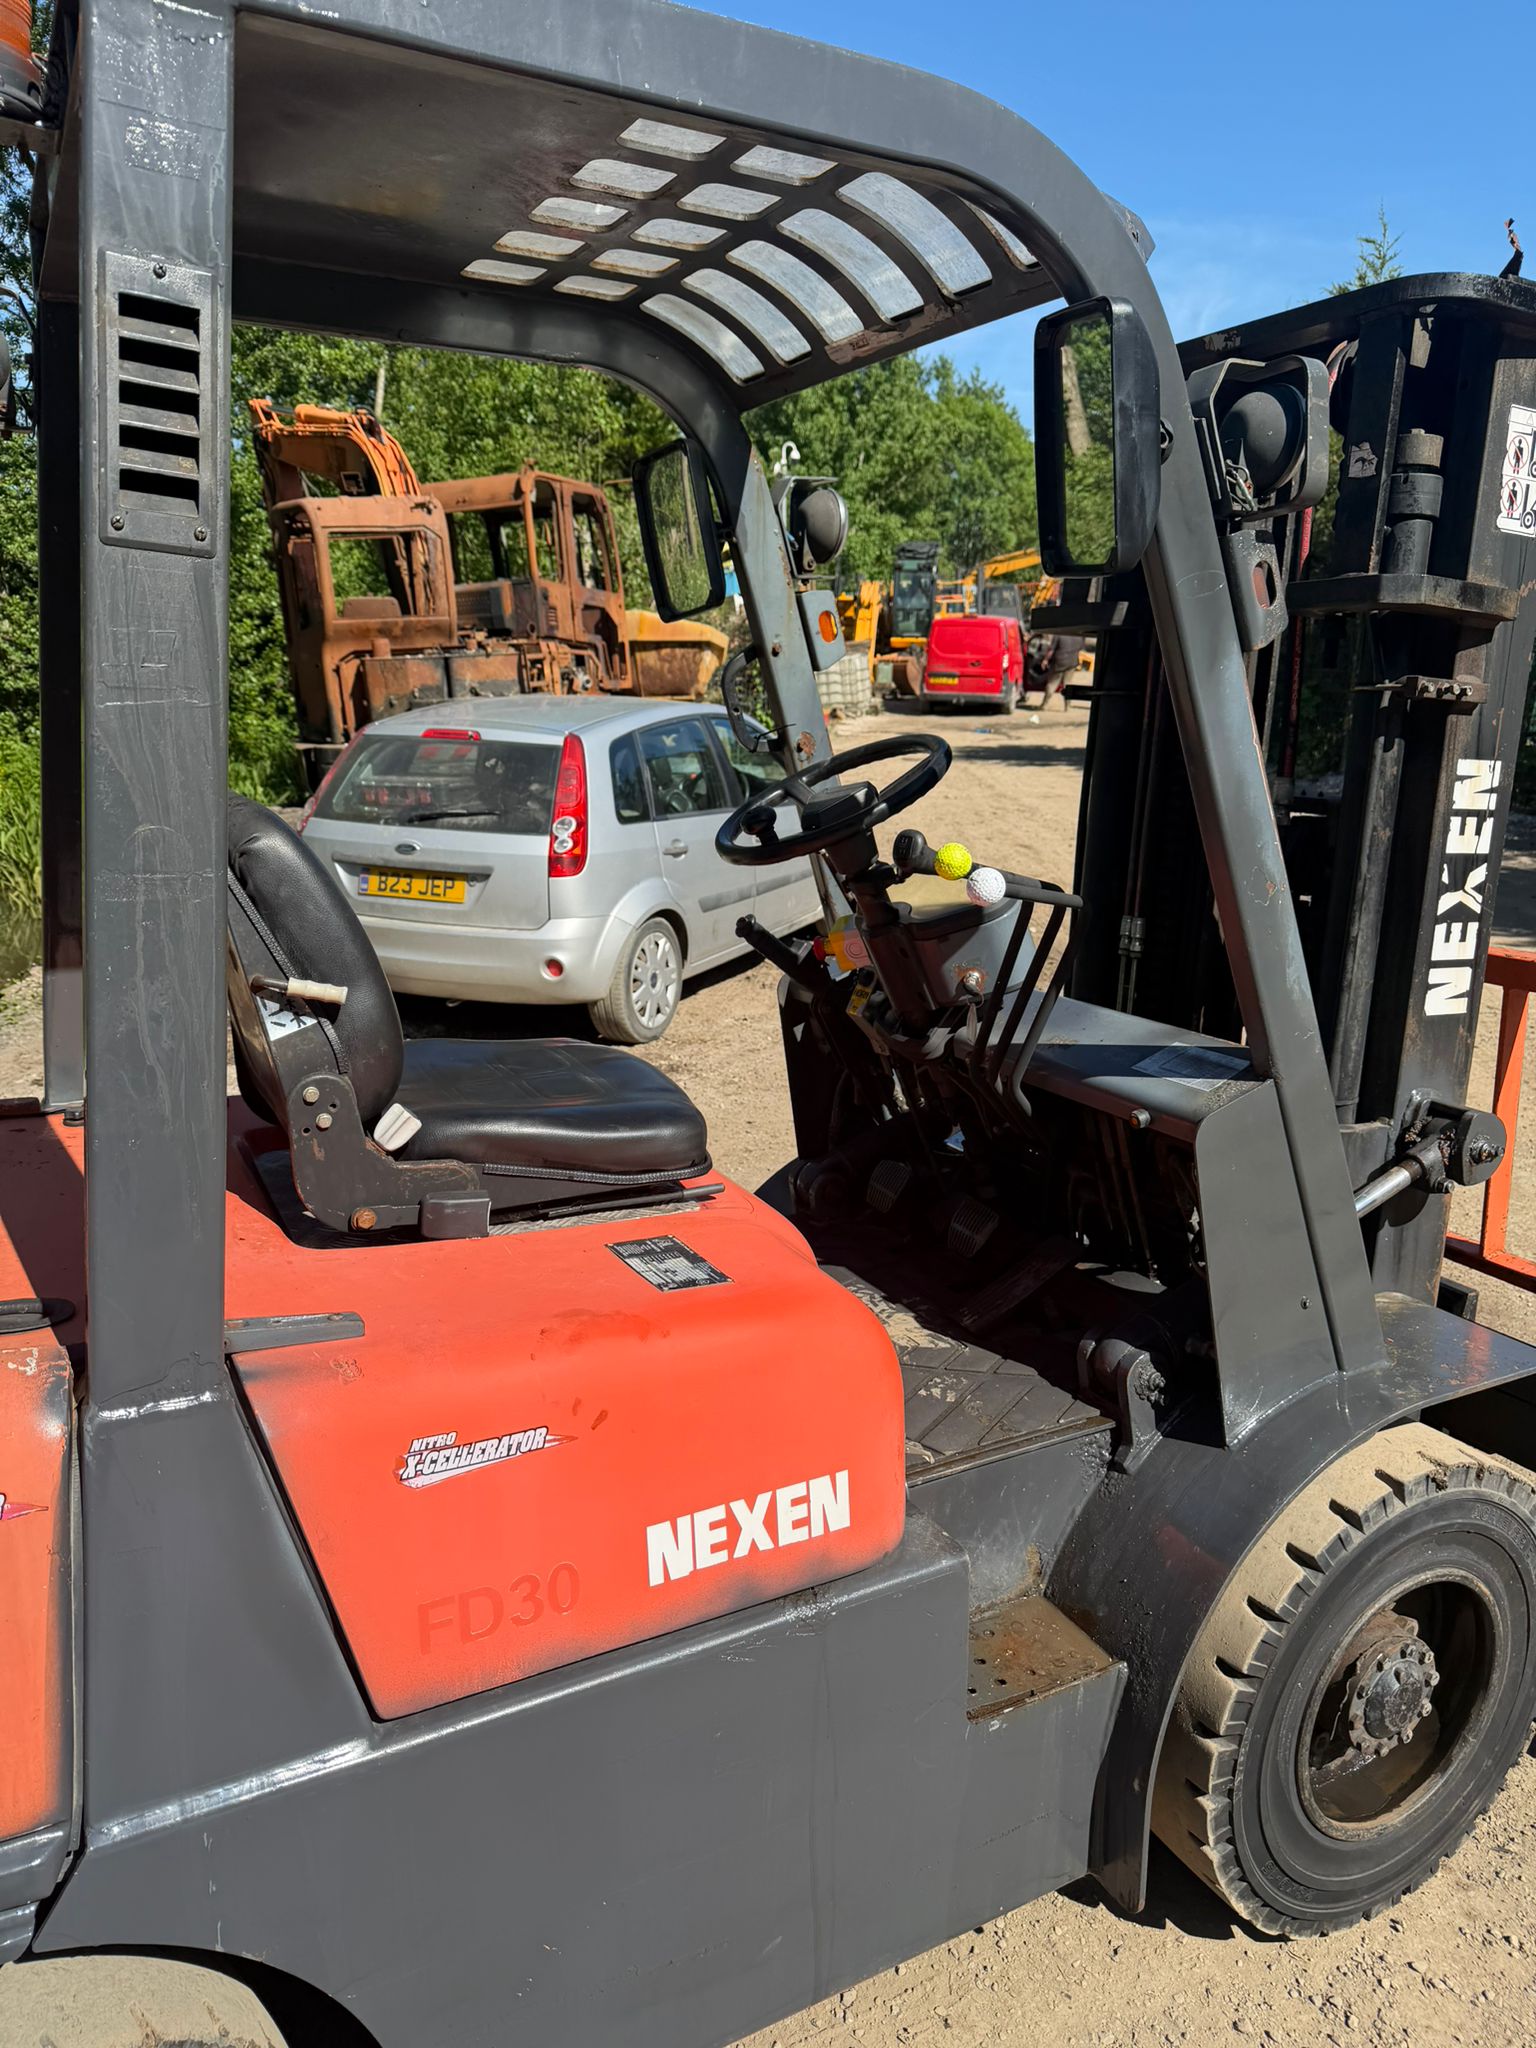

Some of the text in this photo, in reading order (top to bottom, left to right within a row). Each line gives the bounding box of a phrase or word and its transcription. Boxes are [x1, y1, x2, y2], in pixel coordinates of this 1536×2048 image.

[377, 871, 455, 897] B23 JEP
[1424, 758, 1502, 1017] NEXEN
[400, 1426, 548, 1481] X-CELLERATOR
[408, 1431, 458, 1453] NITRO
[646, 1469, 850, 1587] NEXEN
[417, 1561, 580, 1657] FD30
